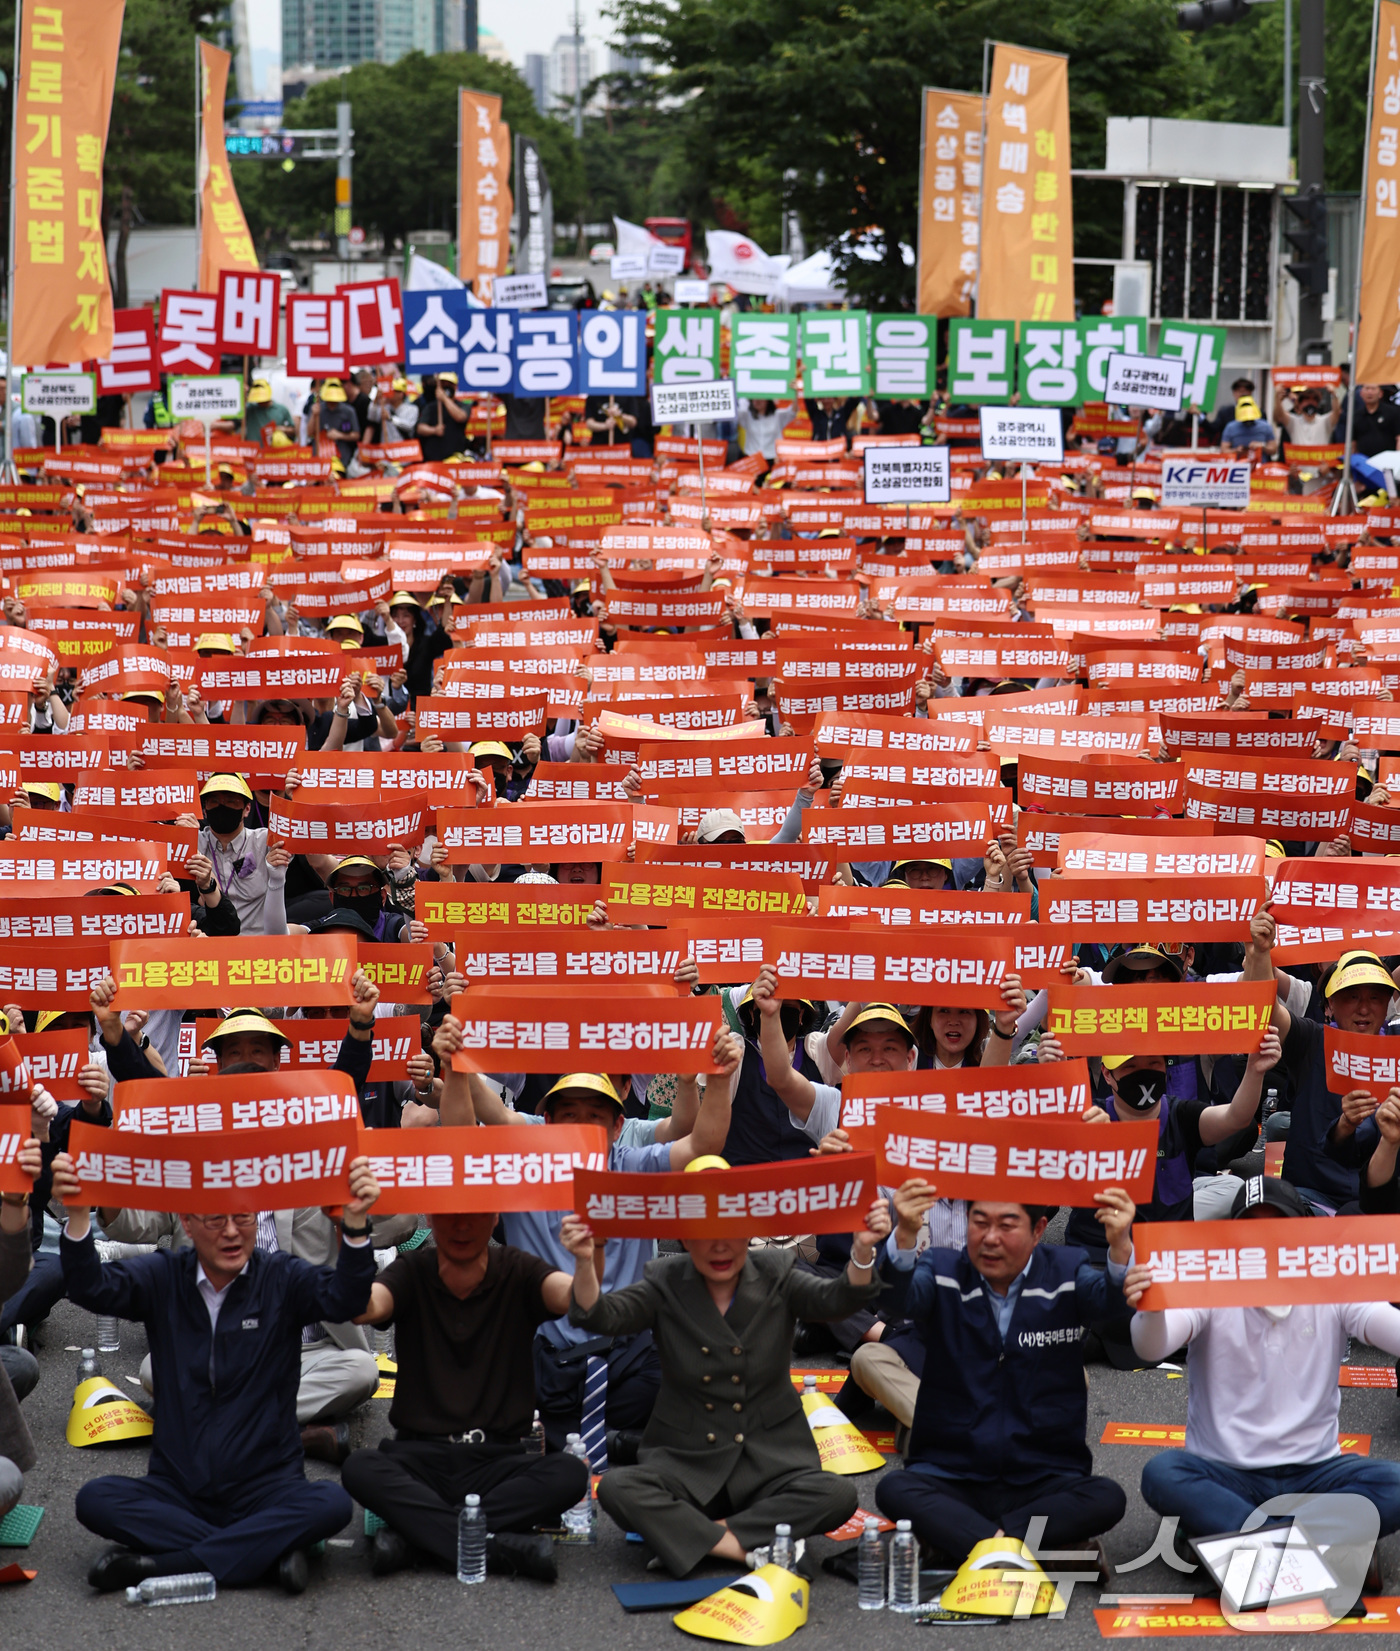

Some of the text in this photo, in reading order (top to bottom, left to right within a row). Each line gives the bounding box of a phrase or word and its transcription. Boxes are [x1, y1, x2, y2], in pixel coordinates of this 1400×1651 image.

[25, 7, 65, 264] 근로기준법
[995, 62, 1030, 215] 새벽배송
[932, 104, 960, 222] 소상공인
[1030, 128, 1058, 320] 허용반대!!
[408, 295, 638, 392] 소상공인
[657, 315, 930, 395] 생존권을
[1122, 368, 1169, 383] 대구광역시
[657, 388, 730, 403] 전북특별자치도
[1111, 381, 1177, 397] 소상공인연합회
[658, 401, 732, 415] 소상공인연합회
[997, 421, 1046, 433] 광주광역시
[988, 435, 1056, 447] 소상공인연합회
[871, 462, 943, 474] 전북특별자치도
[1166, 467, 1248, 484] KFME
[871, 476, 943, 488] 소상공인연합회
[652, 536, 711, 550] 보장하라!!
[25, 553, 75, 569] 보장하라!!
[752, 548, 852, 562] 생존권을 보장하라!!
[978, 551, 1078, 570] 생존권을 보장하라!!
[64, 583, 86, 597] 확대
[155, 570, 265, 595] 최저임금 구분적용!!
[1178, 580, 1233, 595] 보장하라!!
[329, 590, 369, 606] 새벽배송
[742, 593, 857, 609] 생존권을 보장하라!!
[894, 596, 1009, 613] 생존권을 보장하라!!
[1031, 588, 1140, 604] 생존권을 보장하라!!
[198, 608, 261, 624] 보장하라!!
[607, 601, 723, 617] 생존권을 보장하라!!
[1093, 618, 1156, 632] 보장하라!!
[57, 640, 113, 656] 확대 저지!!
[474, 629, 594, 648] 생존권을 보장하라!!
[509, 658, 580, 675] 보장하라!!
[704, 650, 758, 667] 생존권을
[940, 649, 1069, 666] 생존권을 보장하라!!
[200, 667, 340, 688] 생존권을 보장하라!!
[639, 665, 706, 681] 보장하라!!
[781, 661, 917, 678] 생존권을 보장하라!!
[1088, 662, 1199, 681] 생존권을 보장하라!!
[444, 681, 505, 699] 생존권을
[1248, 679, 1381, 698] 생존권을 보장하라!!
[779, 689, 913, 715] 생존권을 보장하라!!
[1149, 696, 1220, 713] 보장하라!!
[418, 707, 544, 729] 생존권을 보장하라!!
[658, 711, 736, 730] 보장하라!!
[817, 725, 971, 752] 생존권을 보장하라!!
[988, 725, 1142, 750] 생존권을 보장하라!!
[1164, 729, 1318, 748] 생존권을 보장하라!!
[141, 738, 298, 759] 생존권을 보장하라!!
[19, 750, 103, 769] 보장하라!!
[639, 753, 807, 780] 생존권을 보장하라!!
[300, 768, 468, 789] 생존권을 보장하라!!
[911, 767, 997, 787] 보장하라!!
[1022, 773, 1178, 800] 생존권을 보장하라!!
[1186, 767, 1349, 795] 생존권을 보장하라!!
[120, 785, 195, 805] 보장하라!!
[525, 779, 590, 799] 생존권을
[1186, 799, 1350, 829] 생존권을 보장하라!!
[268, 812, 422, 840] 생존권을 보장하라!!
[443, 823, 626, 847] 생존권을 보장하라!!
[807, 820, 986, 846] 생존권을 보장하라!!
[61, 859, 159, 881] 보장하라!!
[1064, 849, 1257, 874] 생존권을 보장하라!!
[607, 882, 806, 914] 고용정책 전환하라!!
[1272, 880, 1359, 909] 생존권을
[422, 902, 510, 925] 고용정책
[1048, 898, 1258, 924] 생존권을 보장하라!!
[0, 912, 184, 938] 생존권을 보장하라!!
[119, 957, 348, 988] 고용정책 전환하라!!
[464, 950, 681, 976] 생존권을 보장하라!!
[776, 951, 1007, 987] 생존권을 보장하라!!
[1049, 1004, 1274, 1036] 고용정책 전환하라!!
[461, 1020, 713, 1050] 생존권을 보장하라!!
[956, 1085, 1086, 1115] 보장하라!!
[117, 1094, 358, 1134] 생존권을 보장하라!!
[74, 1146, 347, 1191] 생존권을 보장하라!!
[463, 1152, 605, 1185] 보장하라!!
[884, 1134, 1147, 1182] 생존권을 보장하라!!
[586, 1180, 864, 1219] 생존권을 보장하라!!
[1145, 1247, 1267, 1283] 생존권을
[83, 1408, 123, 1431] 더 이상은
[88, 1418, 125, 1439] 생존권을
[957, 1578, 1002, 1594] 더 이상은
[956, 1589, 999, 1605] 생존권을
